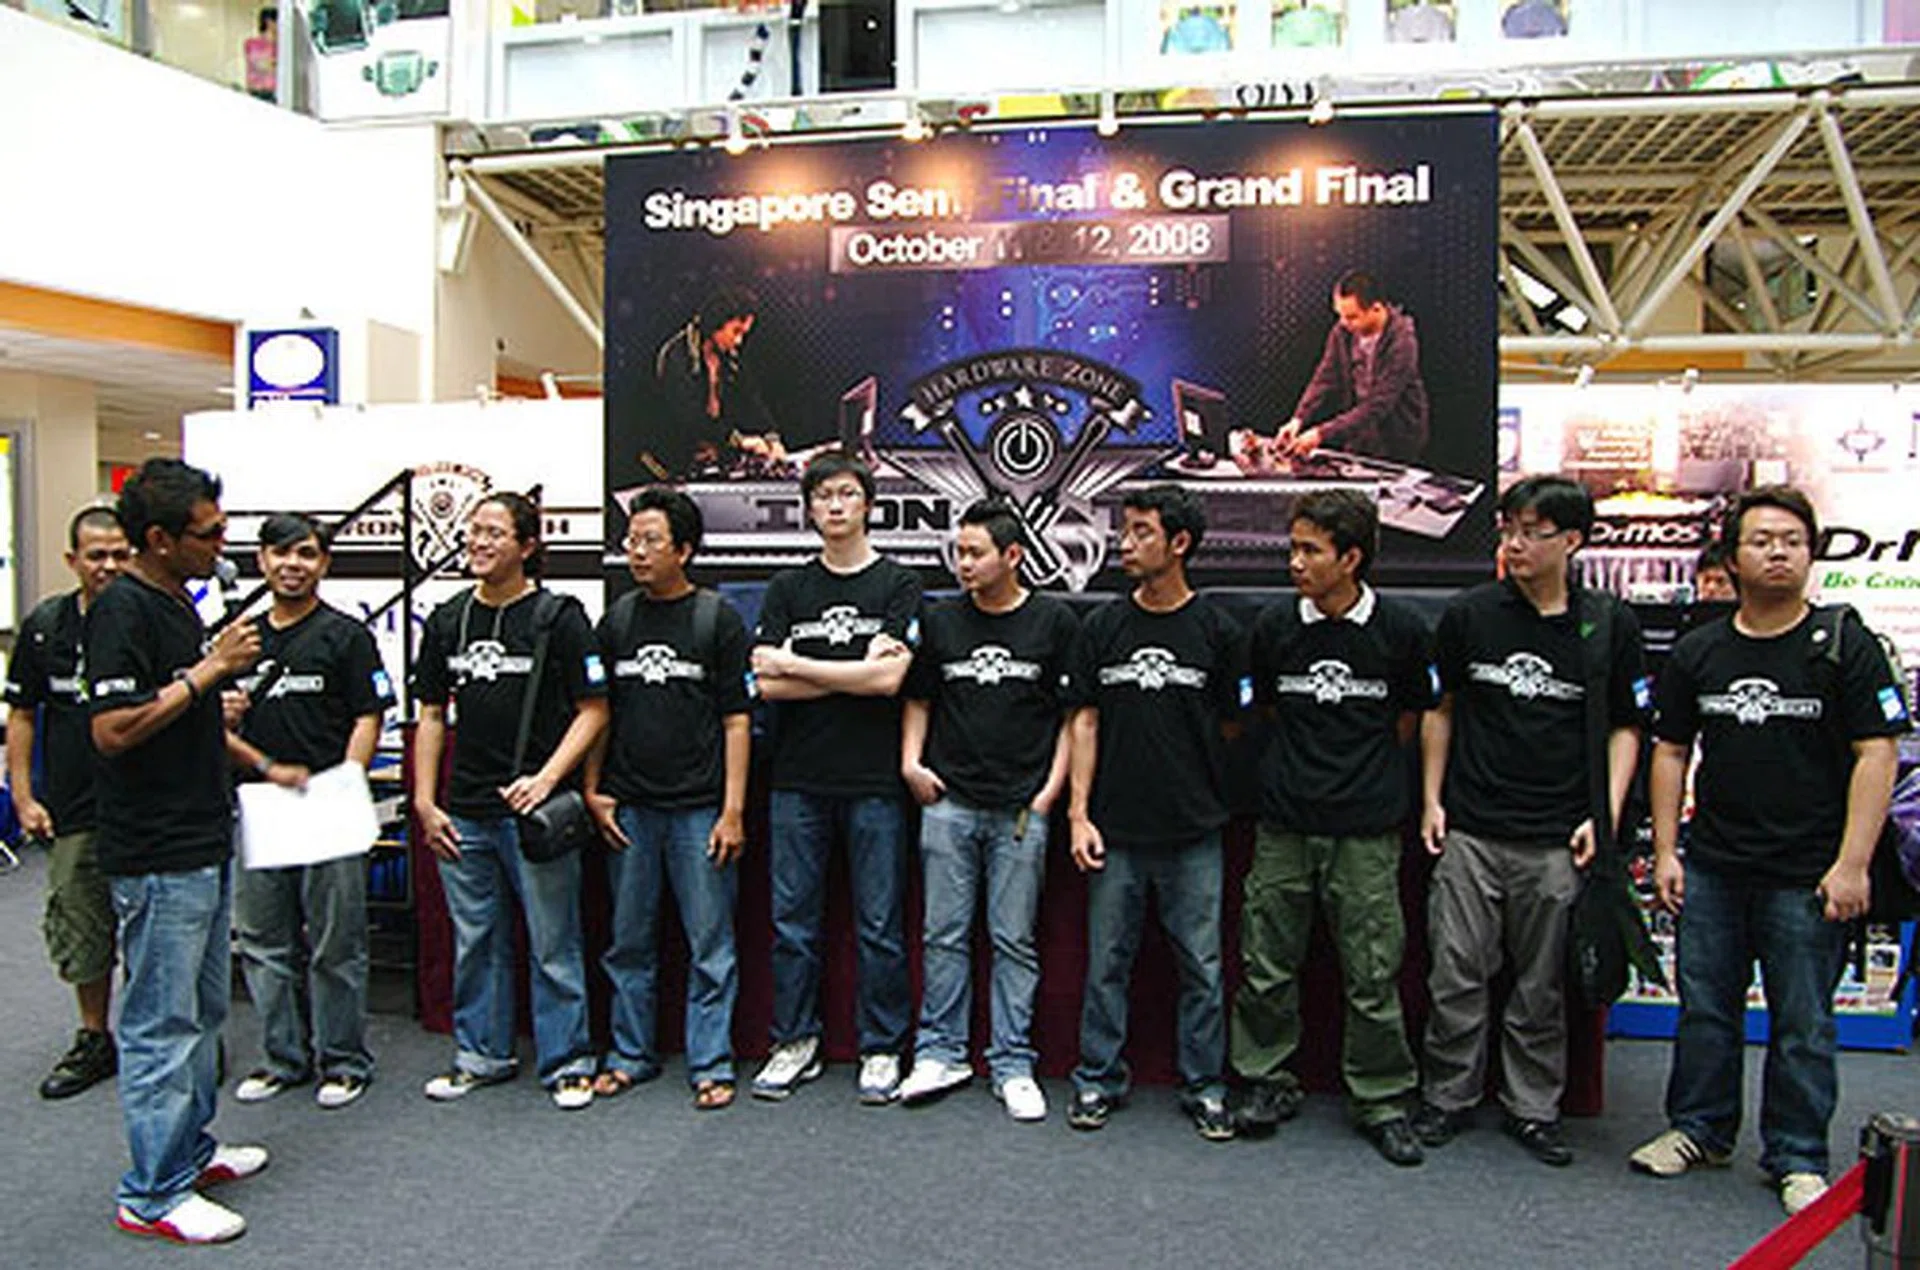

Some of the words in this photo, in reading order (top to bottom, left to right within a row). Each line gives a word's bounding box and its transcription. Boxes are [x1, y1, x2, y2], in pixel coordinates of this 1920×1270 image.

[645, 192, 855, 233] Singapore
[1110, 172, 1147, 210] &
[1159, 167, 1303, 208] Grand
[1315, 164, 1430, 206] Final
[849, 232, 983, 264] October
[1074, 227, 1120, 257] 12,
[1127, 223, 1211, 255] 2008
[918, 357, 1051, 404] HARDWARE
[1062, 361, 1127, 399] ZONE
[755, 499, 951, 531] ION
